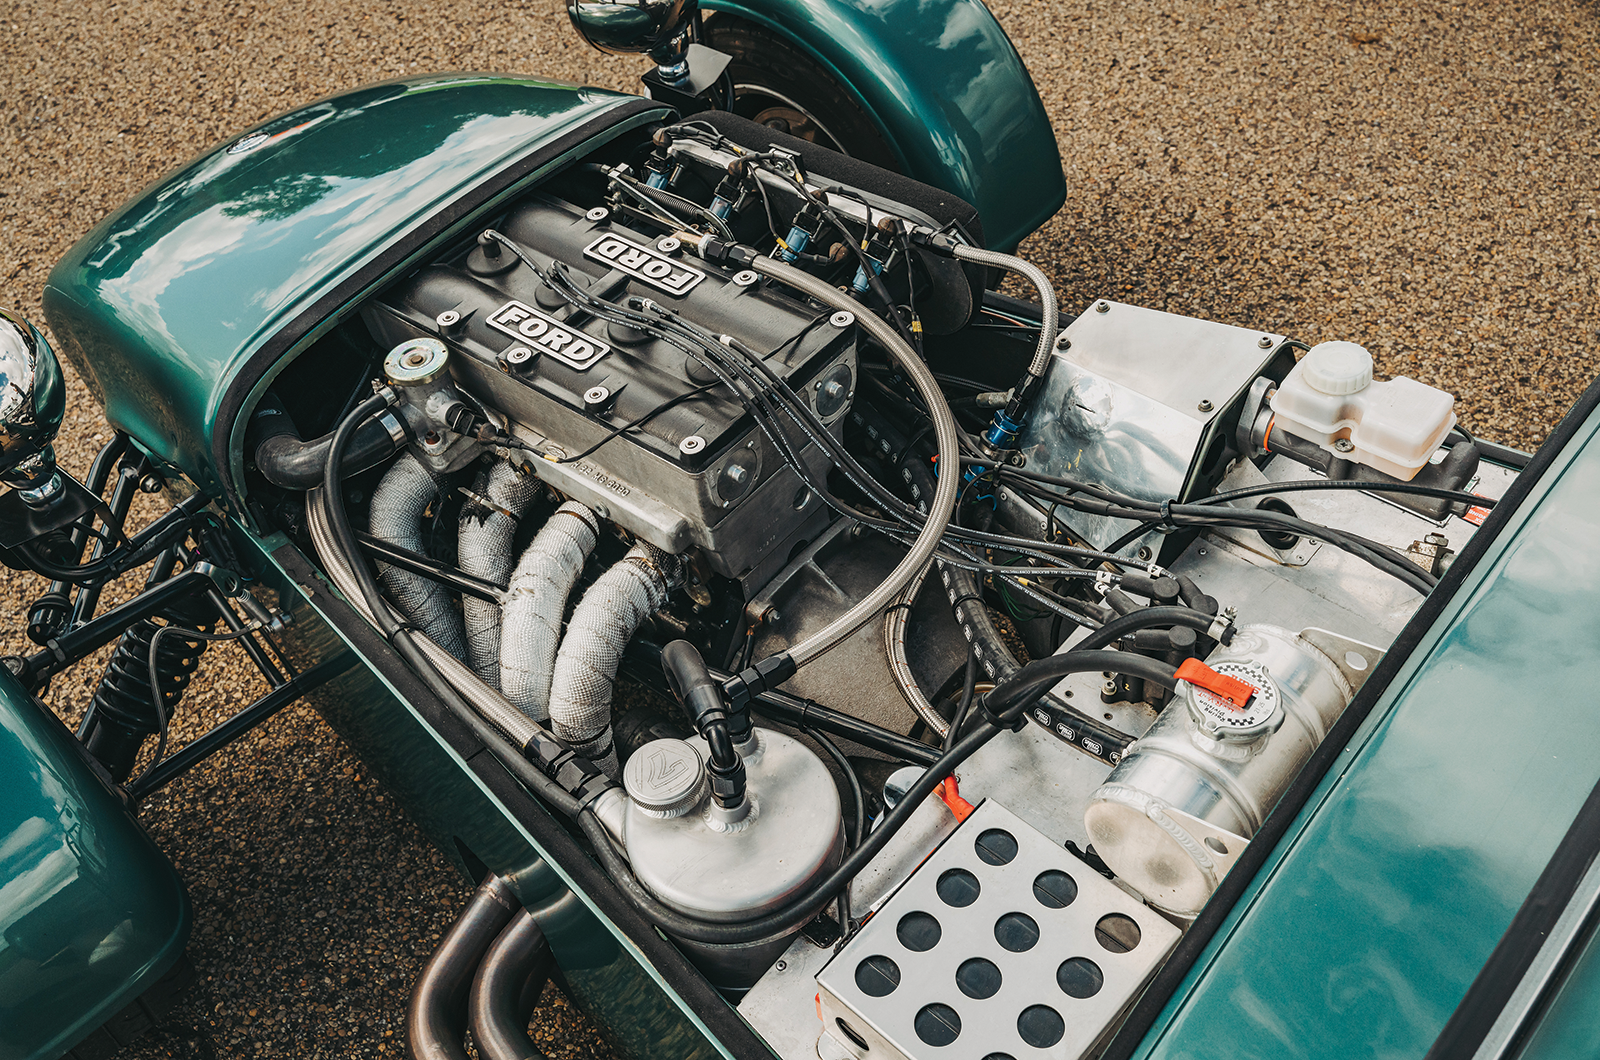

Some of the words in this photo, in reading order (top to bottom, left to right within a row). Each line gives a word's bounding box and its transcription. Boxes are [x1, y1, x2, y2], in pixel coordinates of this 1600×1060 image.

[598, 240, 695, 289] FORD
[497, 306, 594, 360] FORD
[1199, 699, 1226, 716] Division
[1204, 707, 1226, 723] Racing
